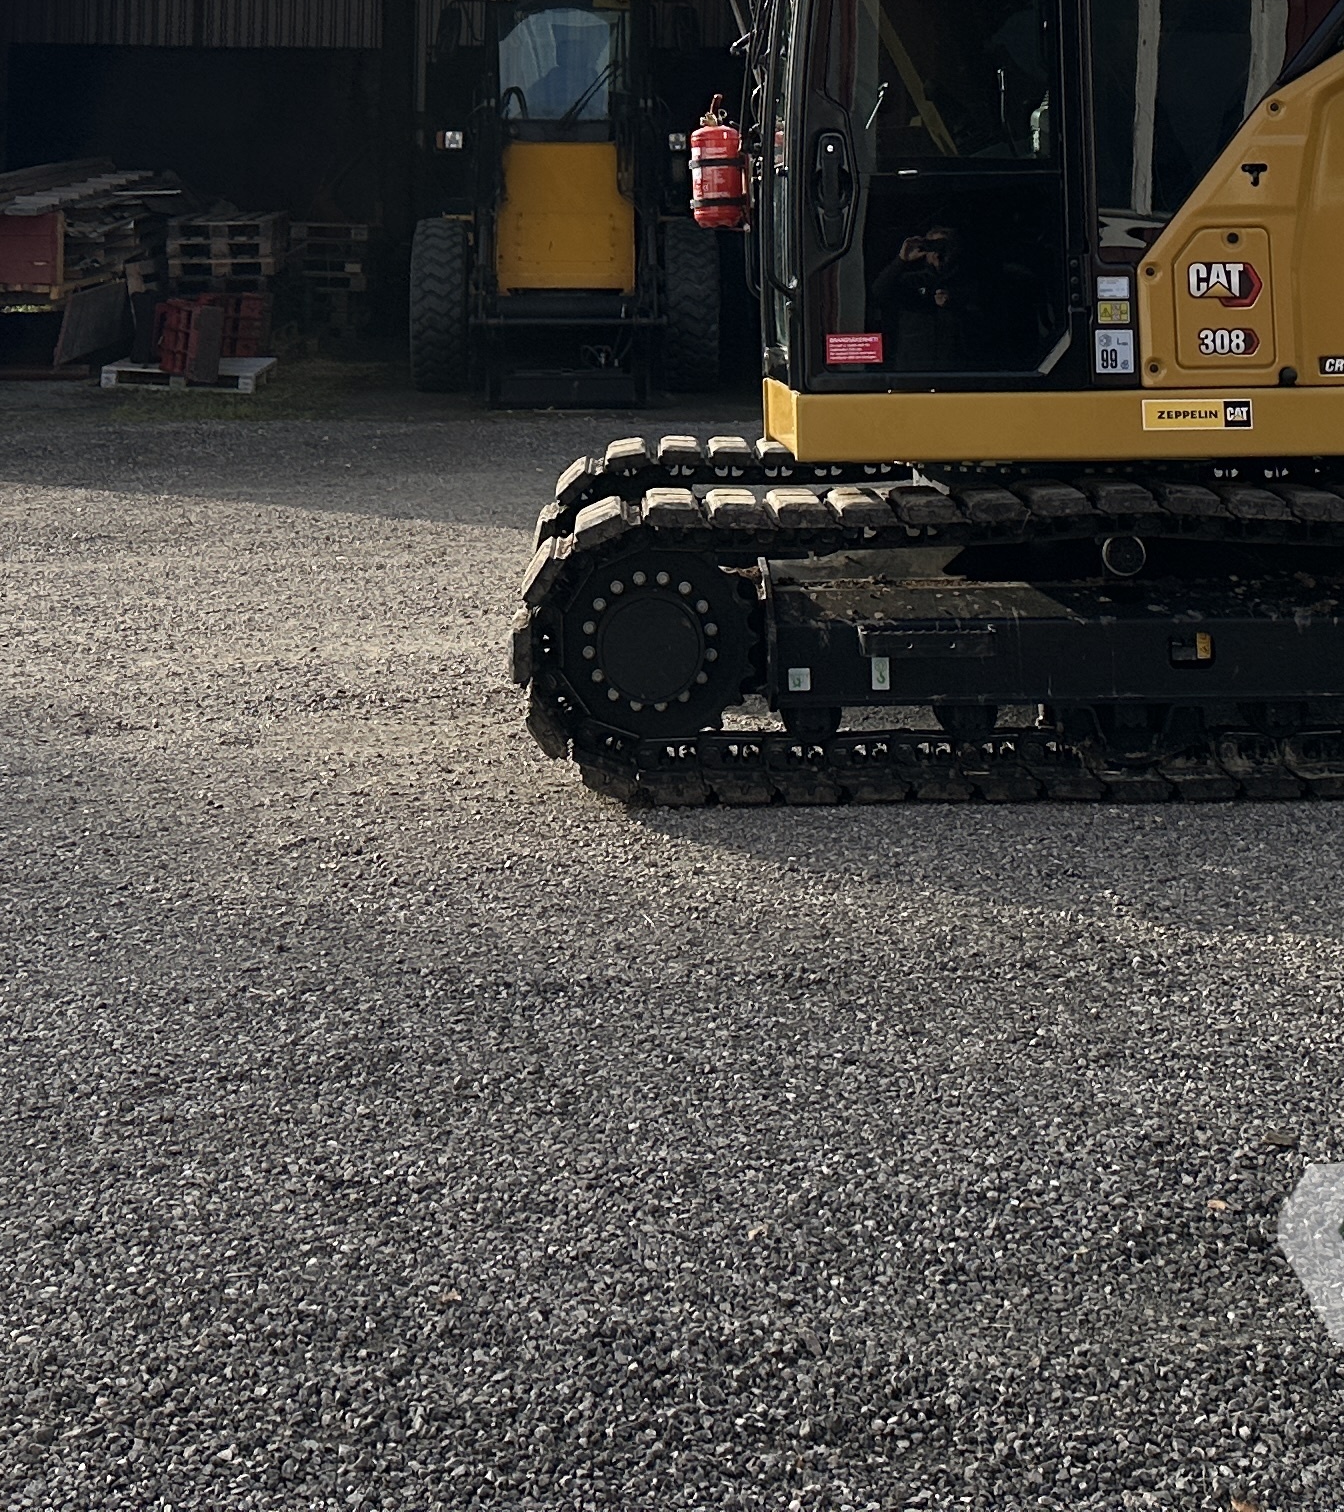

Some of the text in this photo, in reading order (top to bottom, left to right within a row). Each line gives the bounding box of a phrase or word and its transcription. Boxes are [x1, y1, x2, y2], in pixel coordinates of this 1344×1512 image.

[1188, 263, 1244, 297] CAT
[1199, 329, 1246, 355] 308
[1101, 348, 1118, 369] 99
[1157, 406, 1249, 422] ZEPPELIN CAT
